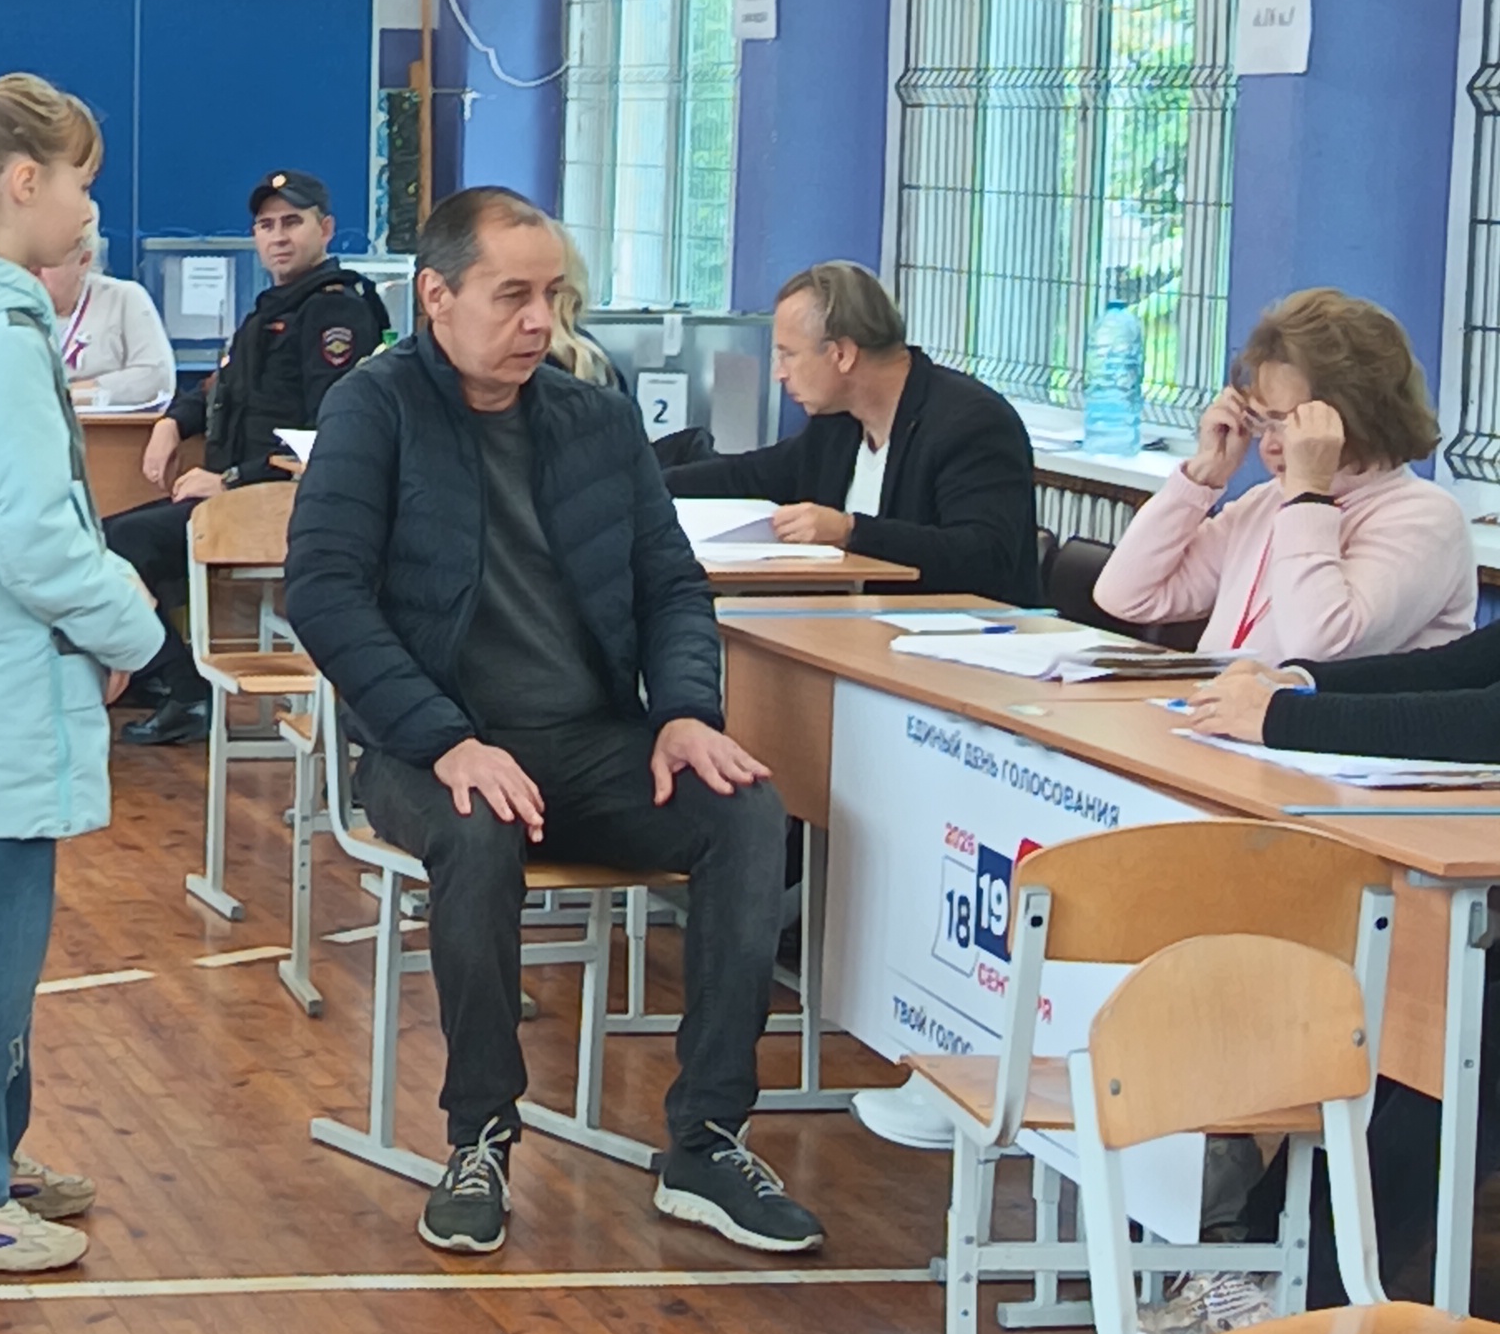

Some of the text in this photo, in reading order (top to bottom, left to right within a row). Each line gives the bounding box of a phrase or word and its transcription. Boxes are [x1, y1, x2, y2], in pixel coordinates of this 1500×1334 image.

[653, 398, 668, 424] 2
[907, 714, 1120, 827] ЕДИНЫЙ ДЕНЬ ГОЛОСОВАНИЯ
[946, 873, 1008, 949] 18 19
[893, 995, 927, 1037] ТВОЙ
